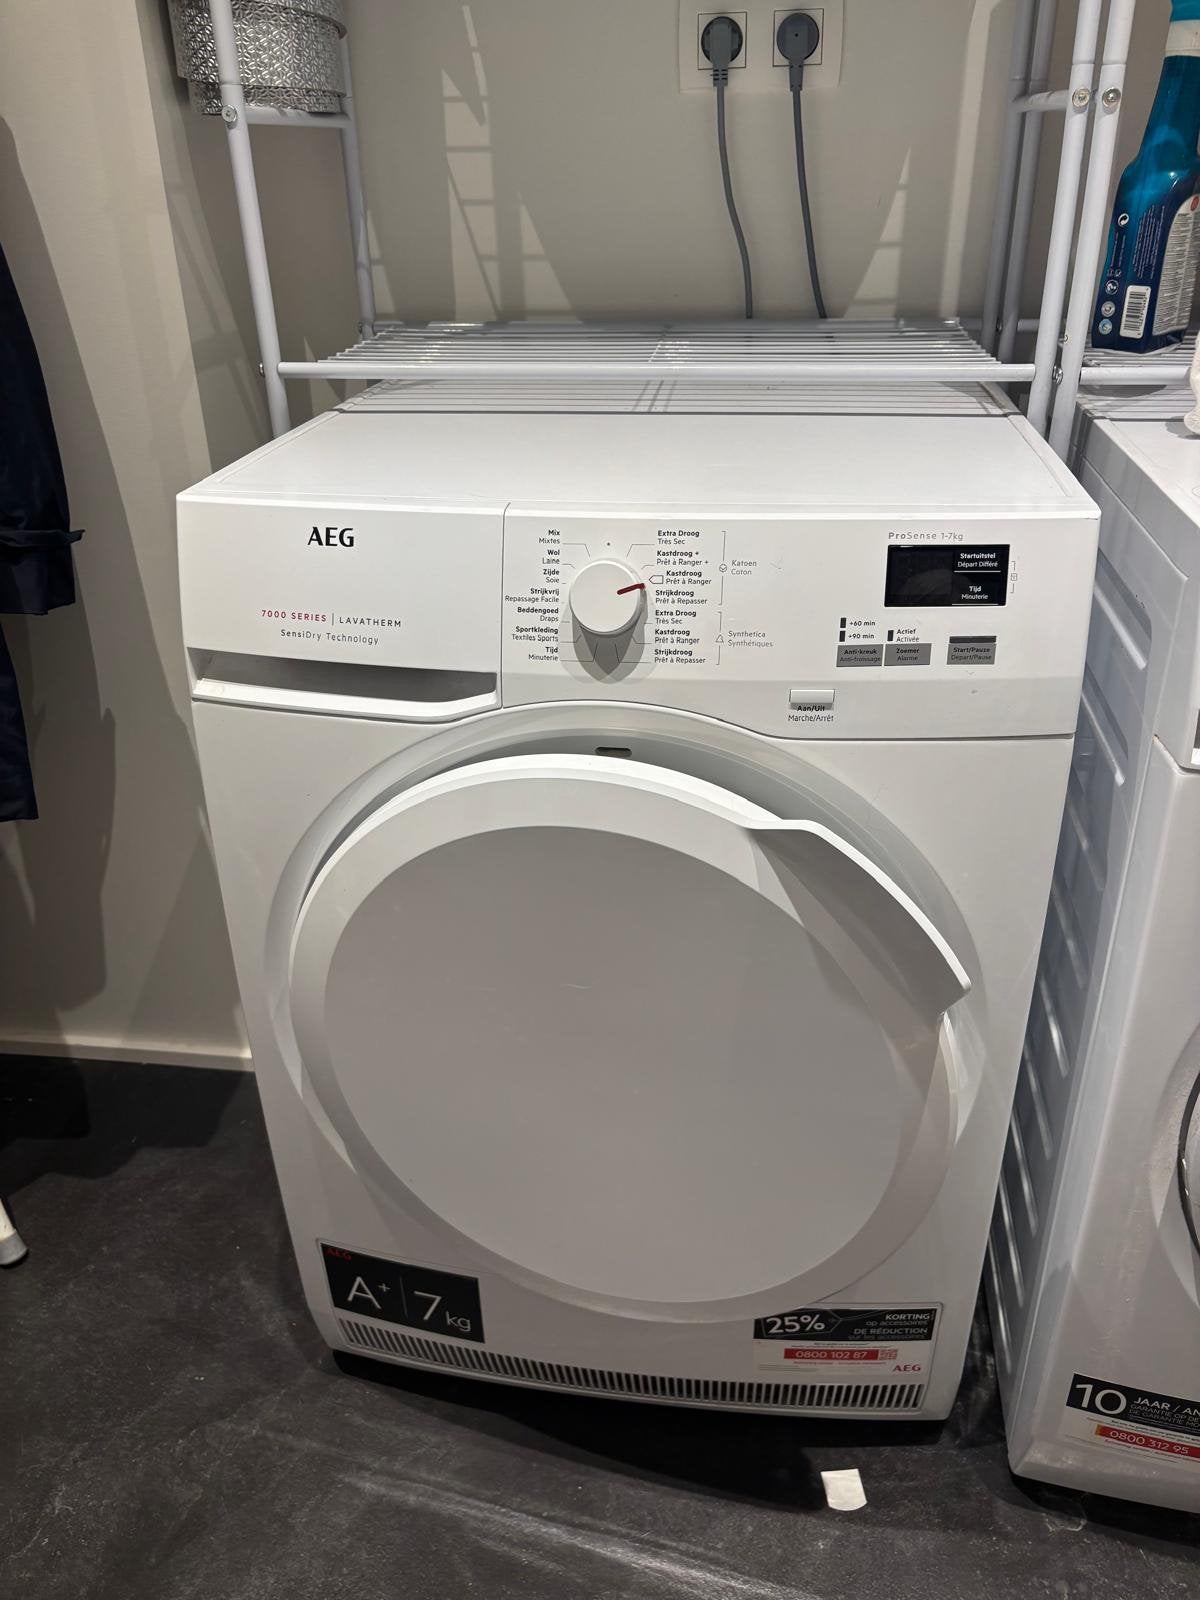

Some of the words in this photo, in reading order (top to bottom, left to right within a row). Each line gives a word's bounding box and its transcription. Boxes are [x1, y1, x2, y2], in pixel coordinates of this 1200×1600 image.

[307, 526, 354, 547] AEG
[678, 530, 700, 538] Droog
[888, 531, 937, 540] ProSense
[941, 532, 964, 541] 1-7kg
[678, 558, 702, 567] Ranger
[543, 568, 560, 576] Zijde
[666, 570, 702, 578] Kastdroog
[687, 578, 712, 586] Ranger
[530, 588, 560, 596] Strijkvrij
[655, 589, 695, 597] Strijkdroog
[505, 595, 540, 603] Repassage
[517, 606, 559, 614] Beddengoed
[261, 609, 287, 619] 7000
[291, 612, 327, 622] SERIES
[339, 616, 401, 628] LAVATHERM
[540, 615, 559, 623] Draps
[515, 625, 559, 634] Sportkleding
[654, 628, 691, 636] Kastdroog
[281, 629, 322, 641] SensiDry
[326, 632, 379, 645] Technology
[512, 633, 536, 641] Textiles
[537, 634, 559, 642] Sports
[728, 630, 766, 638] Synthetica
[676, 637, 700, 645] Ranger
[728, 640, 774, 648] Synthétiques
[545, 646, 558, 654] Tijd
[675, 657, 706, 665] Repasser
[788, 714, 834, 722] Marche/Arrêt
[765, 1313, 826, 1334] 25%
[795, 1350, 828, 1359] 0800
[831, 1350, 851, 1359] 102
[893, 1364, 921, 1372] AEG
[1075, 1384, 1127, 1415] 10
[1133, 1396, 1171, 1411] JAAR
[1130, 1404, 1173, 1418] GARANTIE
[1109, 1430, 1145, 1445] 0800
[1148, 1439, 1170, 1451] 312
[1172, 1445, 1190, 1455] 95
